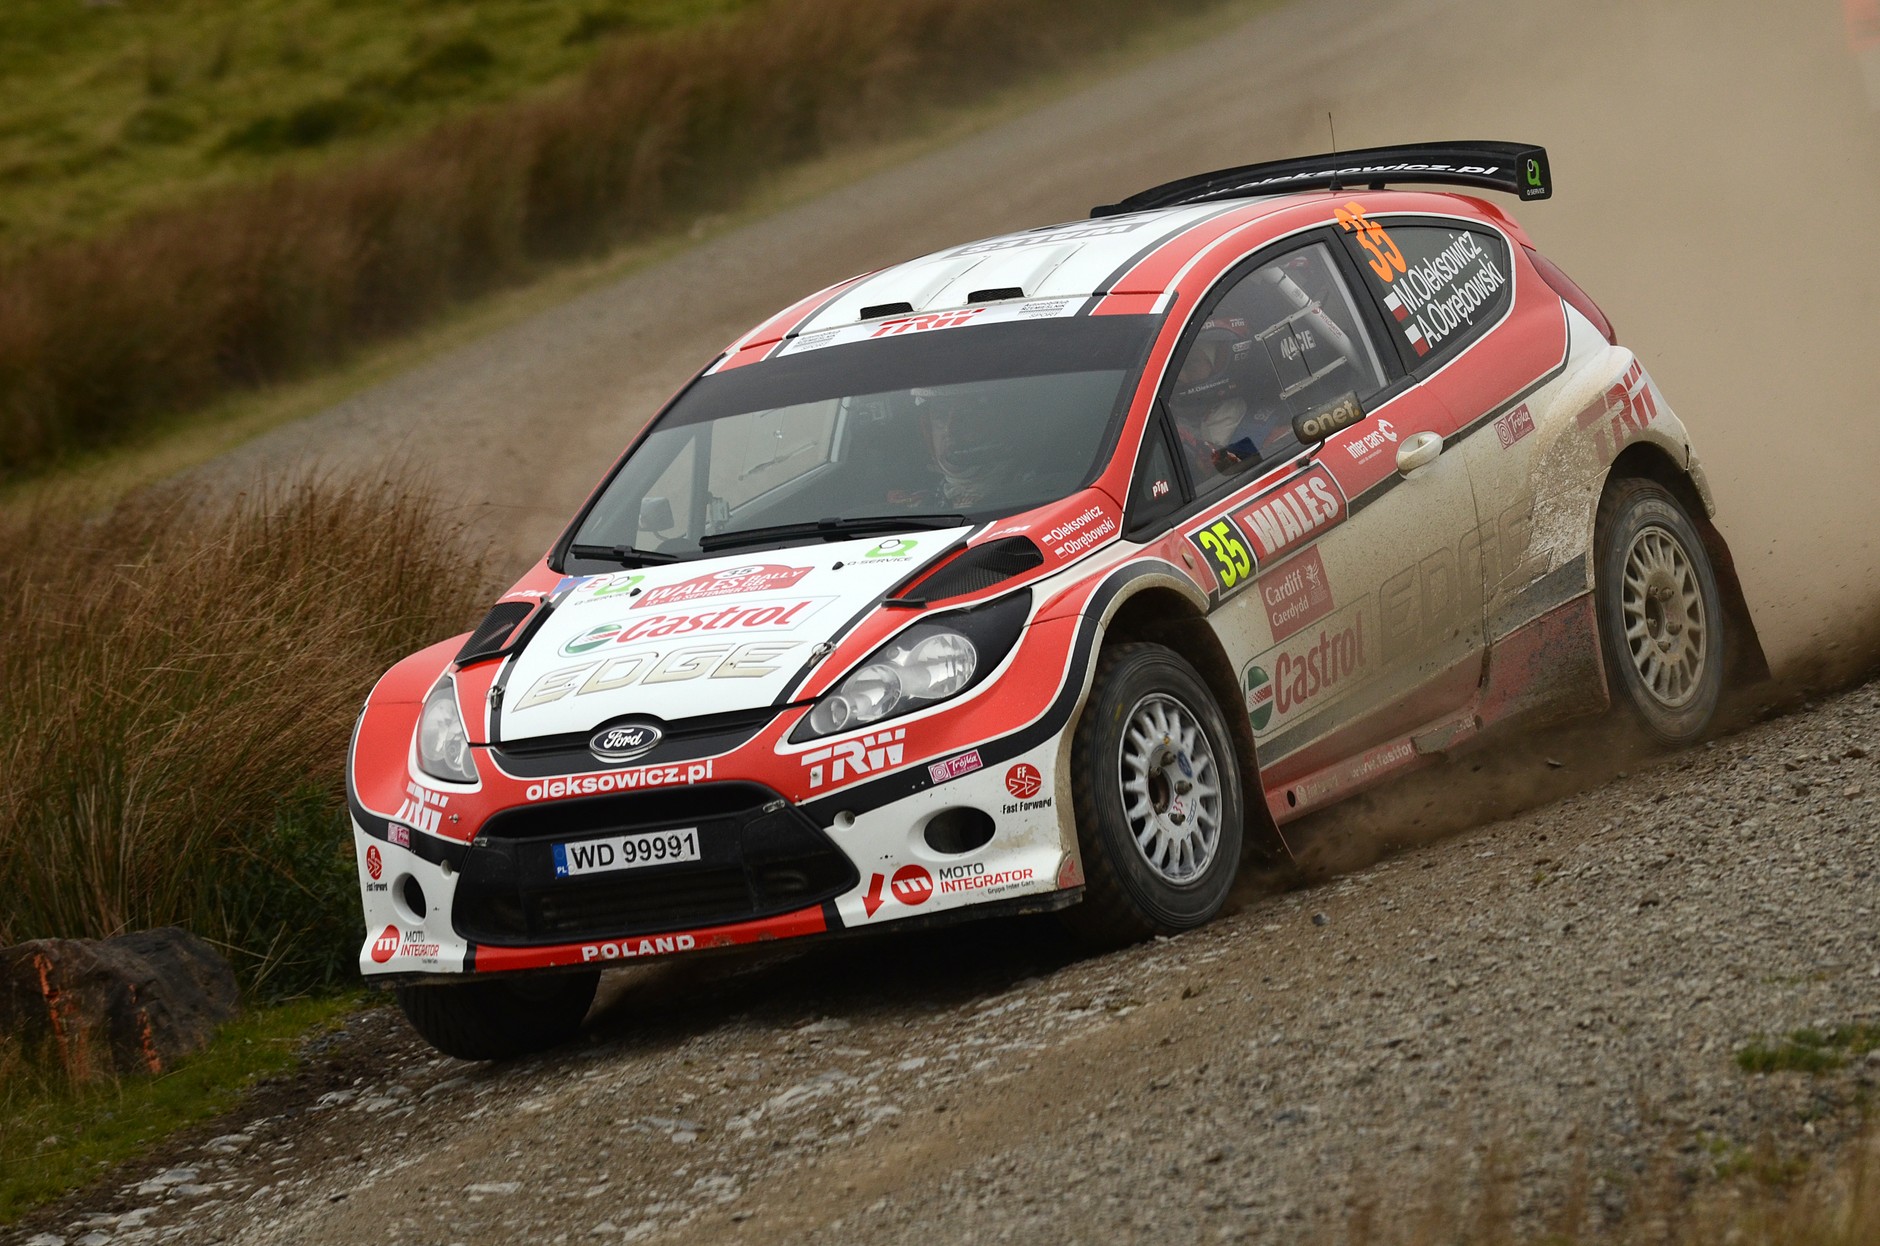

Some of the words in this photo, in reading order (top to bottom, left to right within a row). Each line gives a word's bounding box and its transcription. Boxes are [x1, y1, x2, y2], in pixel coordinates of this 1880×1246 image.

[1333, 201, 1407, 283] 35
[1392, 230, 1482, 315] M.Oleksowicz
[1416, 253, 1505, 349] A.Obrębowski
[870, 308, 987, 338] TRW
[1576, 358, 1658, 465] TRW
[1343, 439, 1369, 459] inter
[1363, 430, 1385, 449] cars
[1152, 480, 1169, 498] PTM
[1051, 505, 1104, 541] Oleksowicz
[1243, 476, 1339, 556] WALES
[1064, 516, 1116, 554] Obrębowski
[1199, 521, 1251, 588] 35
[647, 576, 746, 599] WALES
[722, 567, 754, 578] 35
[749, 570, 804, 581] RALLY
[1265, 568, 1304, 606] Cardiff
[683, 588, 743, 600] SEPTEMBER
[616, 601, 802, 643] Castrol
[1272, 595, 1309, 627] Caerdydd
[512, 641, 808, 713] EDGE
[1274, 609, 1367, 714] Castrol
[603, 728, 644, 749] Ford
[801, 728, 906, 788] TRW
[948, 754, 978, 772] Trójka
[1017, 766, 1027, 778] FF
[526, 760, 713, 800] oleksowicz.pl
[393, 781, 449, 833] TRW
[1002, 802, 1018, 815] Fast
[1019, 797, 1052, 812] Forward
[570, 844, 615, 869] WD
[622, 833, 695, 863] 99991
[556, 866, 567, 874] PL
[939, 862, 985, 880] MOTO
[940, 868, 1033, 893] INTEGRATOR
[401, 944, 440, 957] INTEGRATOR
[403, 931, 425, 943] MOTO
[582, 935, 696, 962] POLAND
